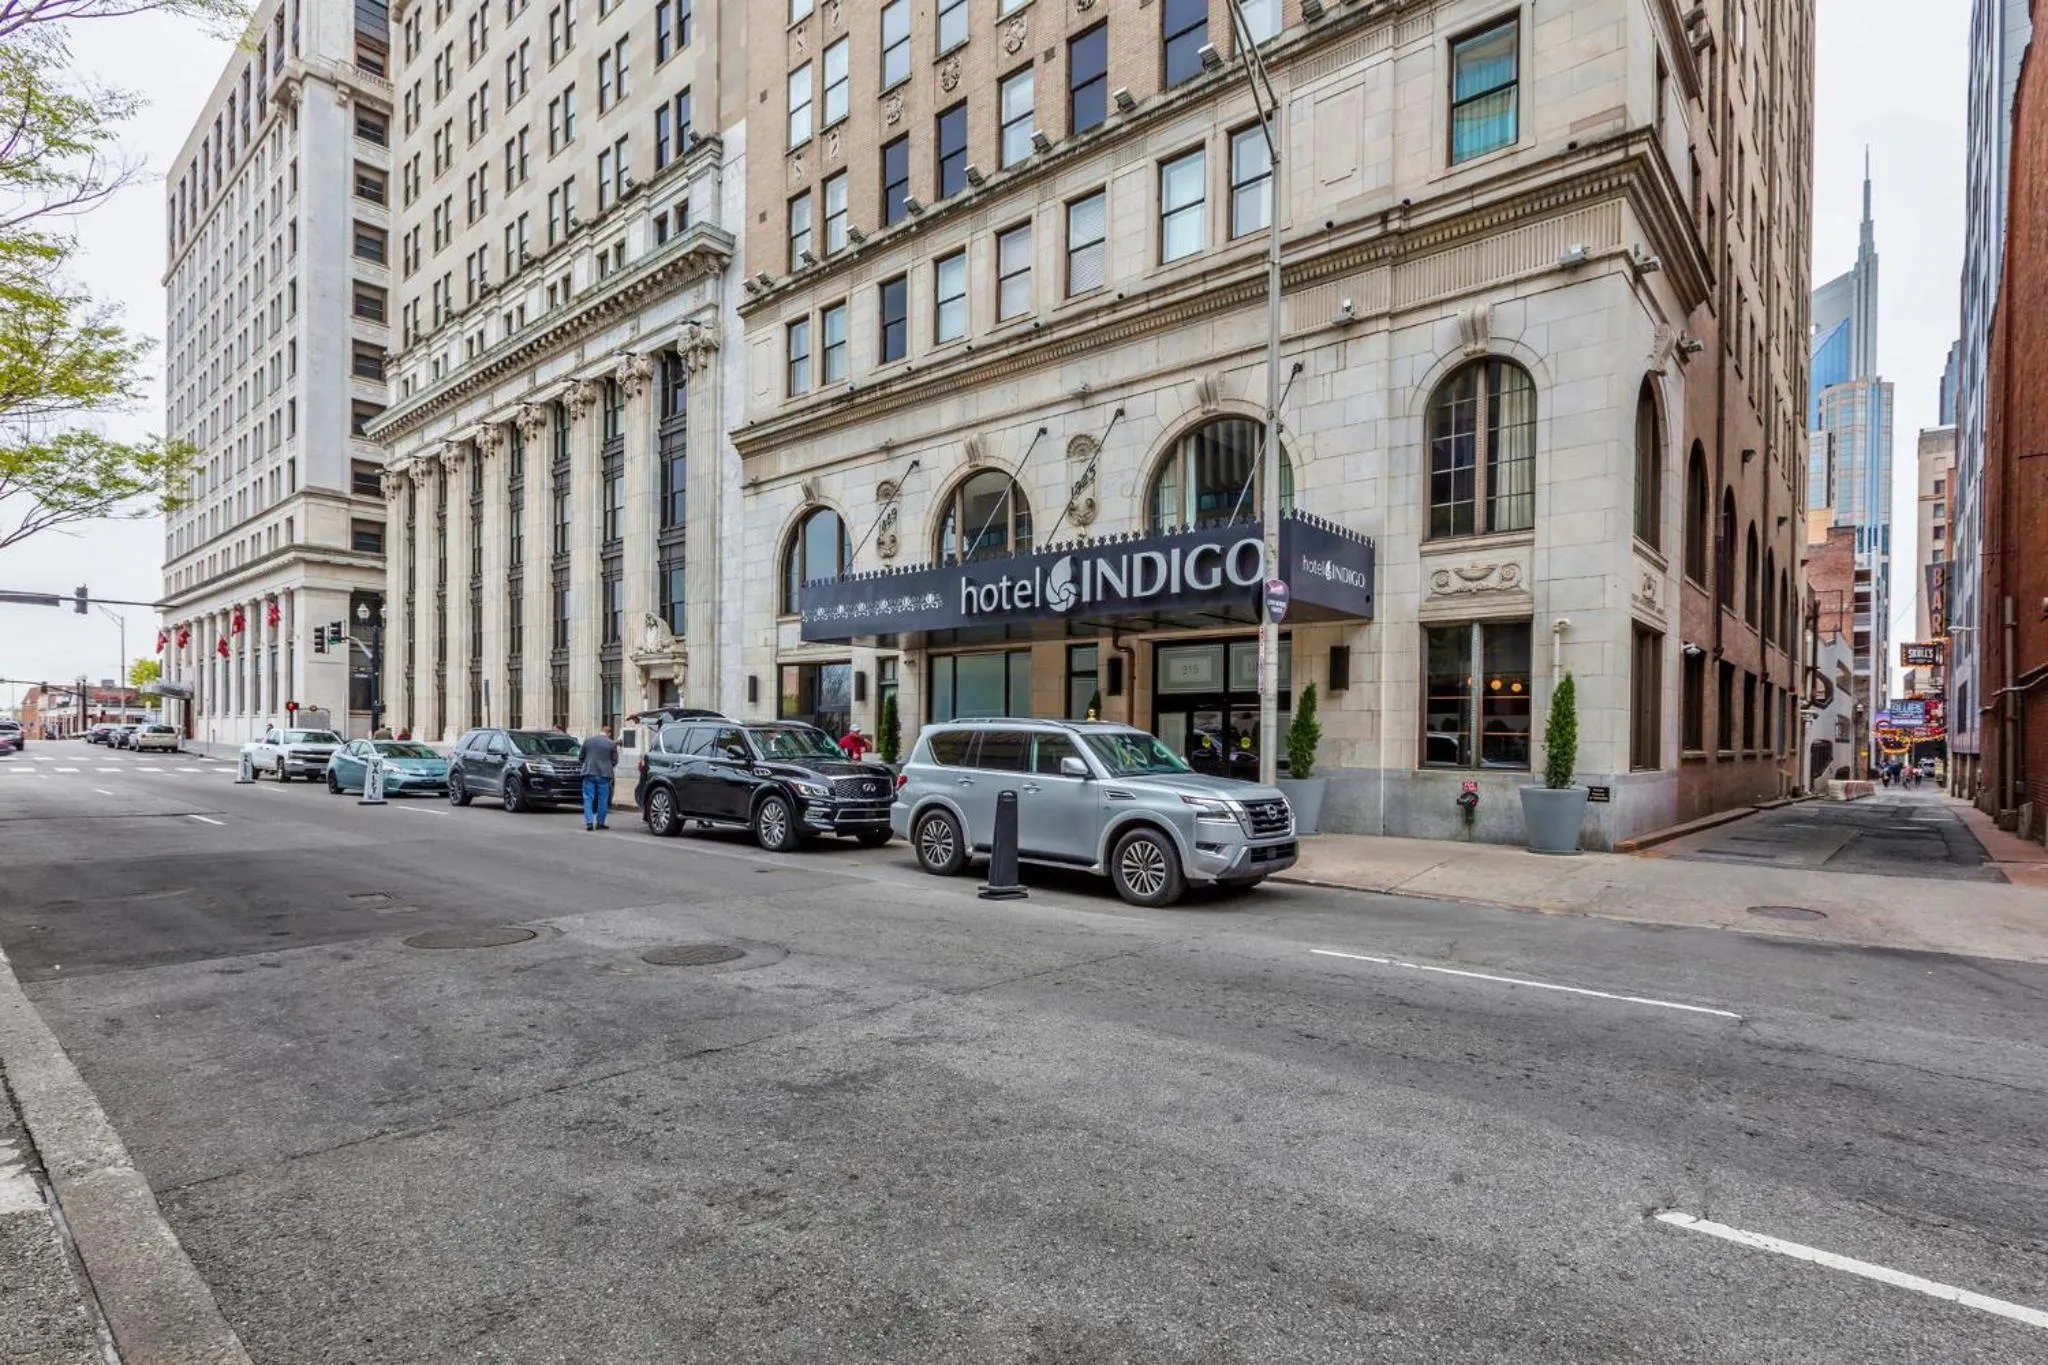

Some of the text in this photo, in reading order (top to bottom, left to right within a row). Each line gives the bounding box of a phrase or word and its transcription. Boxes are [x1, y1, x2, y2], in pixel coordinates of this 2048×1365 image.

[960, 537, 1265, 615] hotel INDIGO
[1302, 554, 1366, 588] hotel INDIGO
[1932, 567, 1944, 634] BAR
